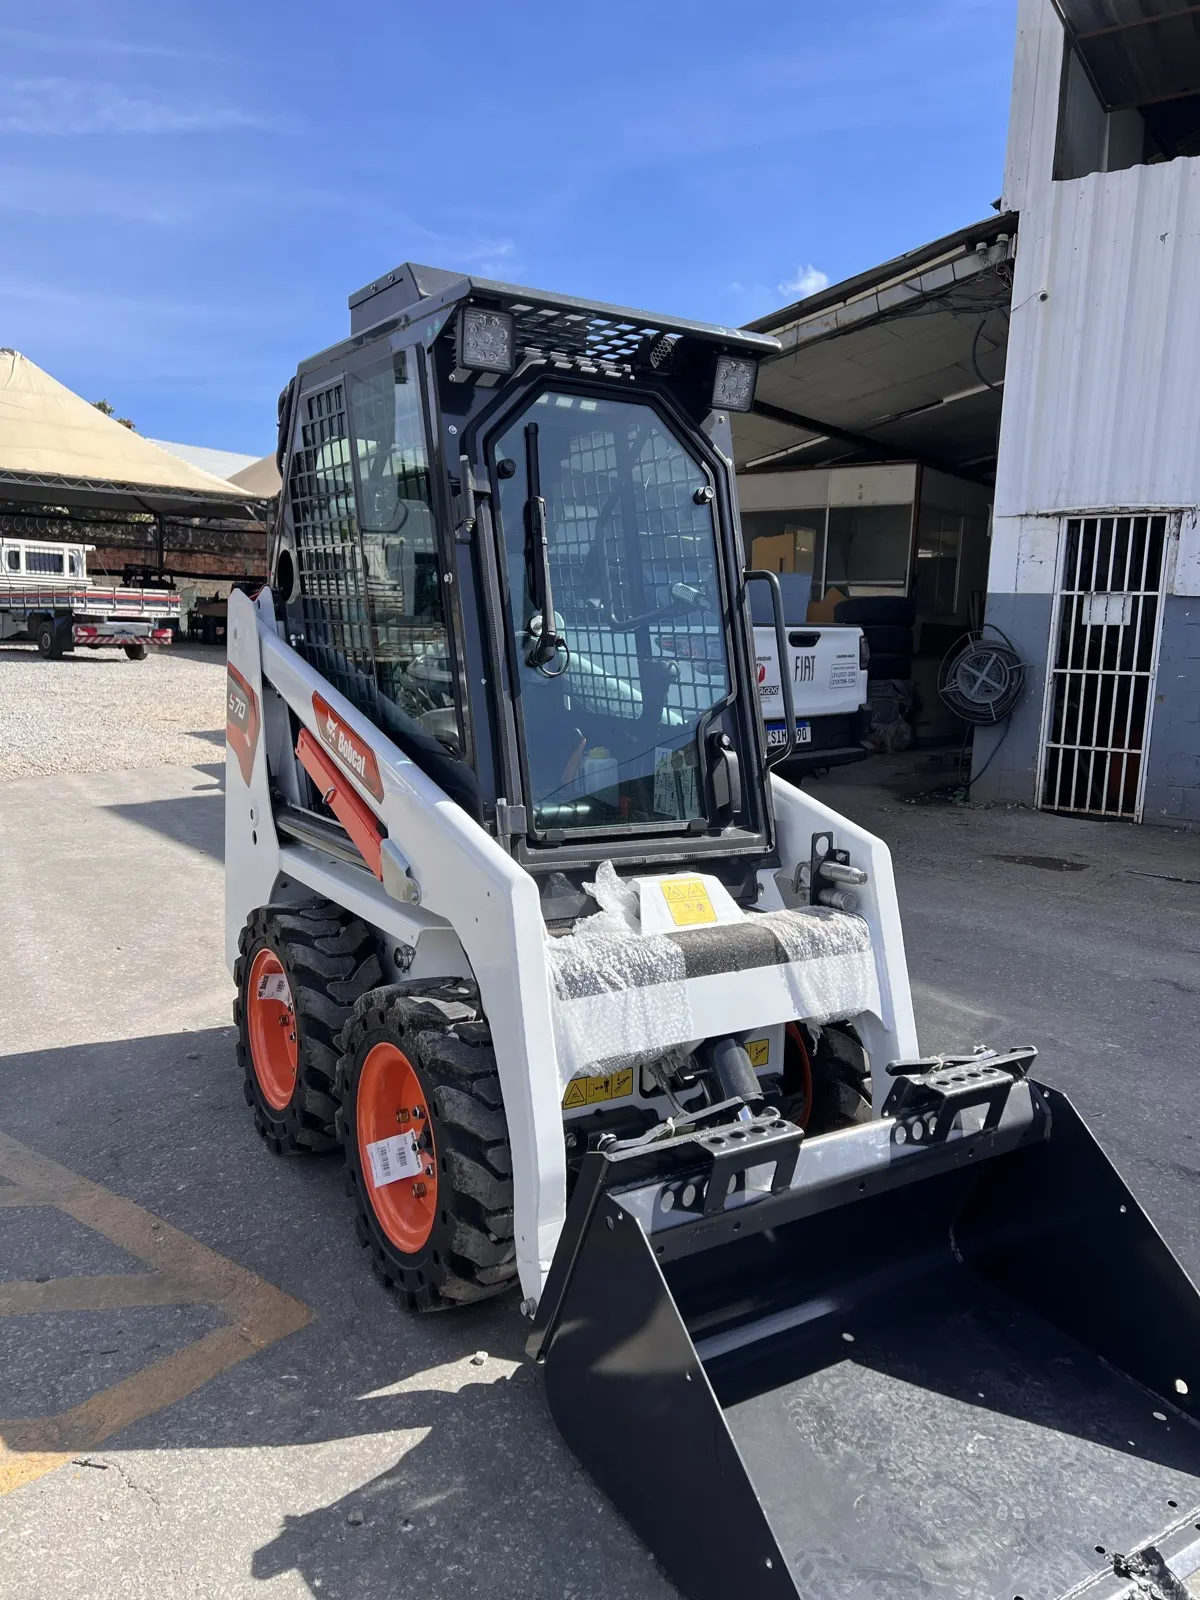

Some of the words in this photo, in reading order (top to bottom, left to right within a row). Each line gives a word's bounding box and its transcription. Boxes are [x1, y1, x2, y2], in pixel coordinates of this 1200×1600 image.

[794, 655, 816, 682] FIAT
[759, 686, 779, 695] AGENS
[228, 692, 246, 720] S70
[338, 730, 366, 777] Bobcat
